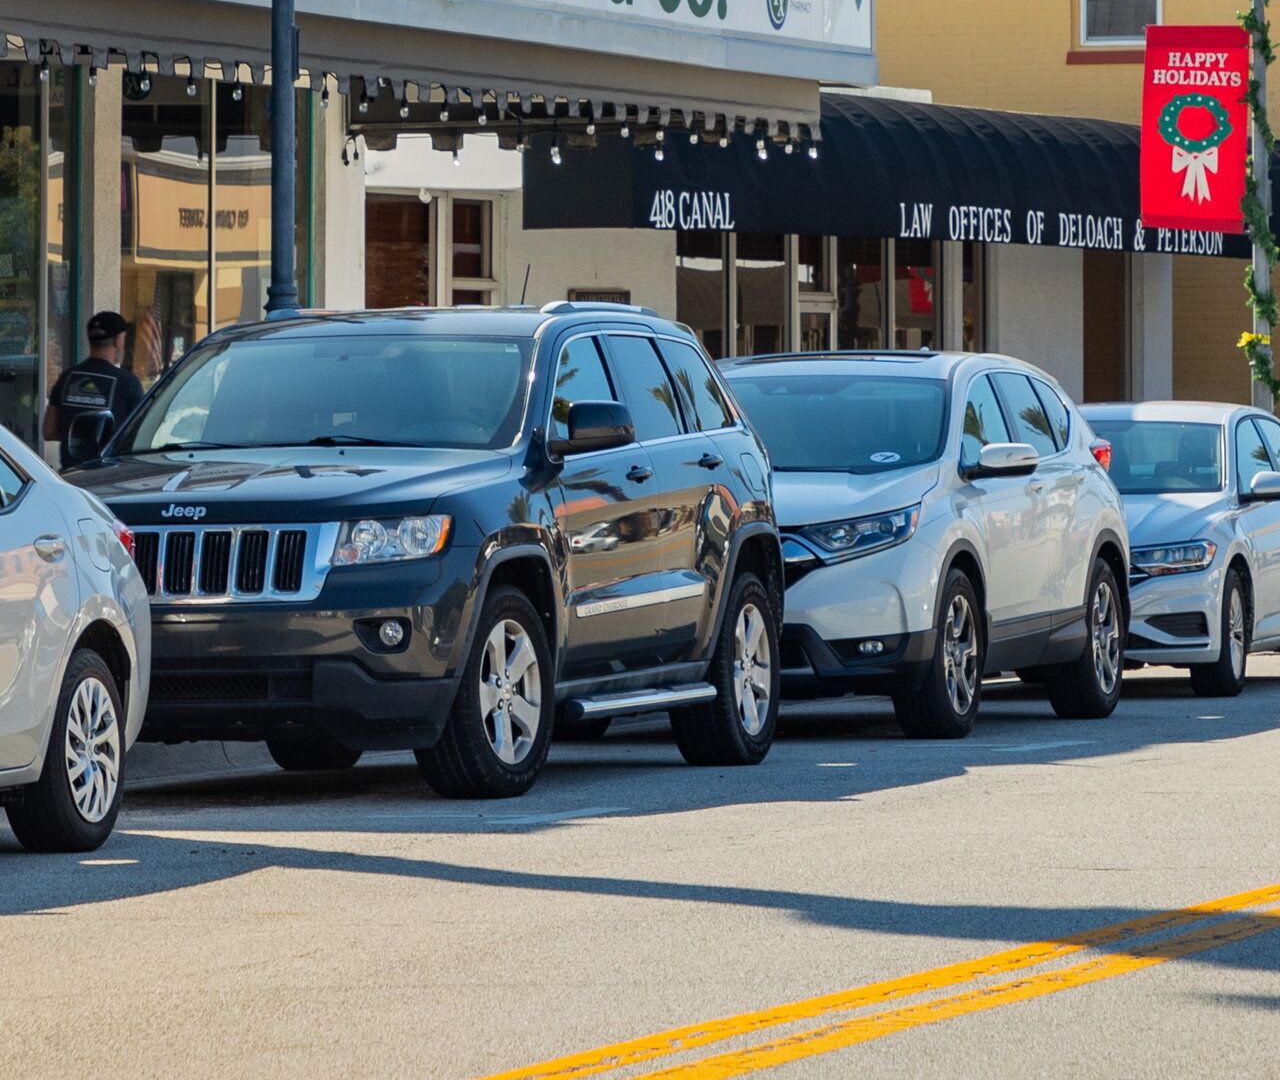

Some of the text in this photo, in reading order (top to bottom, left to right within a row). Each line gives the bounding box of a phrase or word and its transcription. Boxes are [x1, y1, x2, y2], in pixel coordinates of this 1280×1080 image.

[1168, 52, 1229, 69] HAPPY
[1153, 70, 1241, 87] HOLIDAYS
[649, 189, 736, 230] 418 CANAL
[900, 202, 1223, 255] LAW OFFICES OF DELOACH & PETERSON
[161, 503, 207, 520] Jeep
